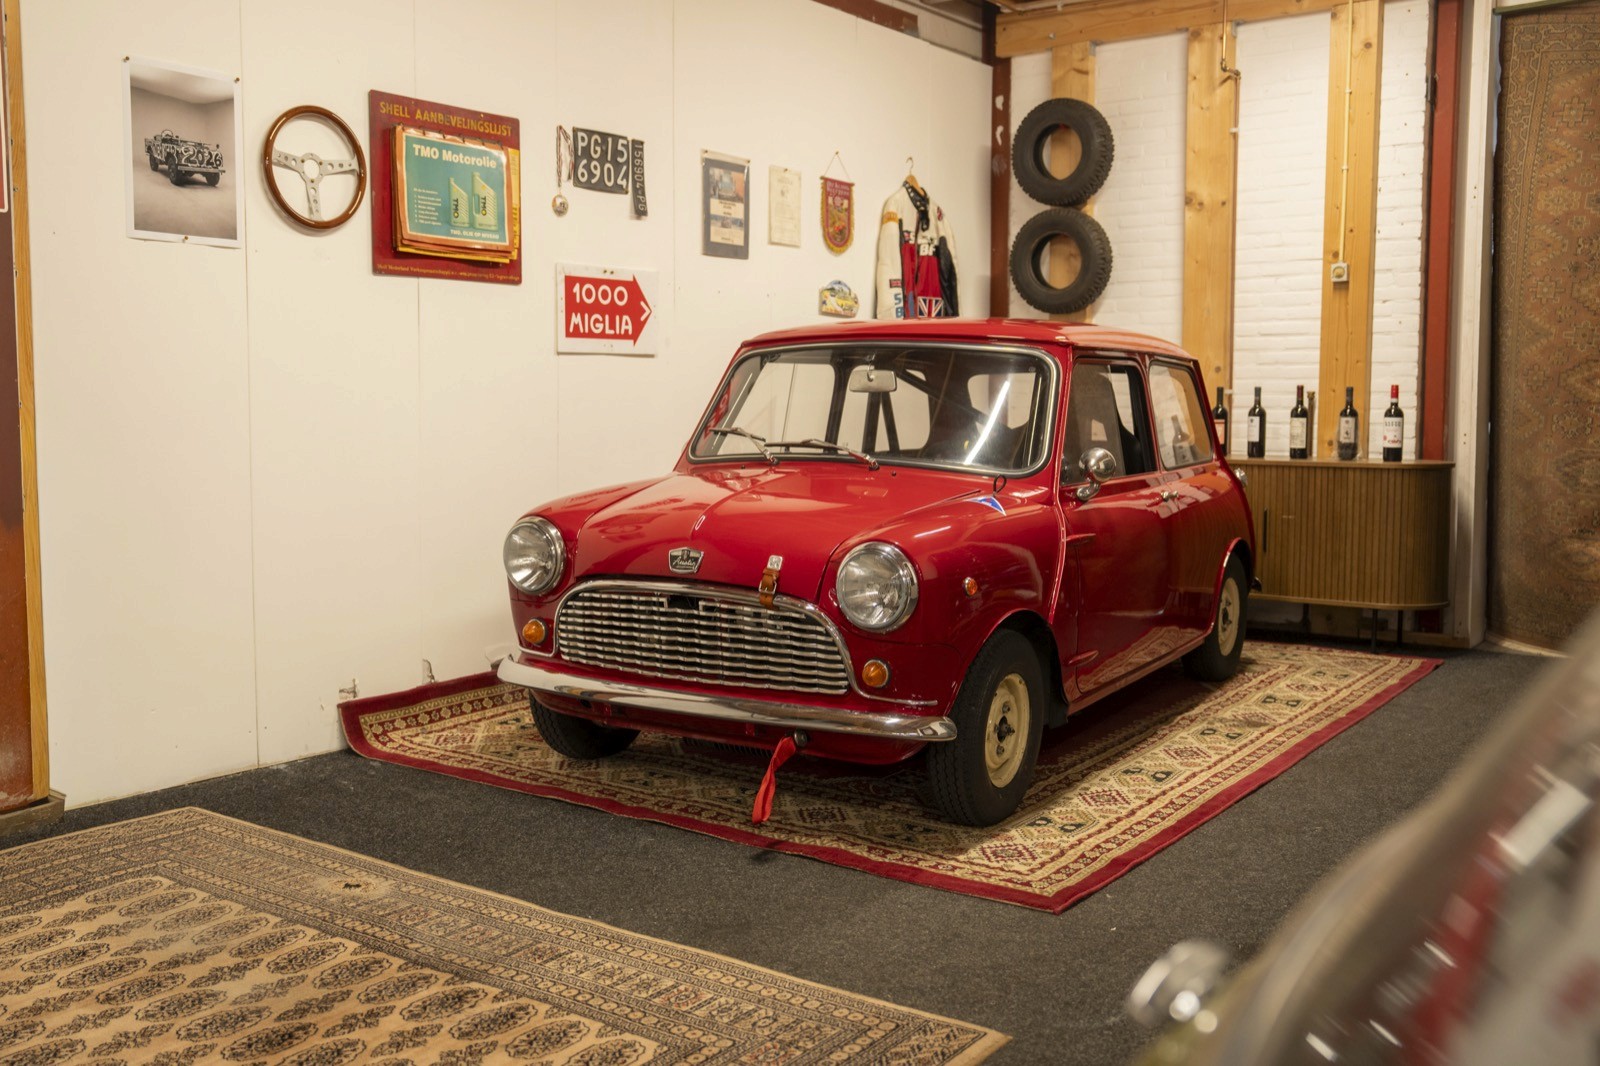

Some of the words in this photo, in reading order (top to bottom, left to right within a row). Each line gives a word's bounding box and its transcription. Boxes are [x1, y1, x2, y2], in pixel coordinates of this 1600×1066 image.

[379, 101, 411, 118] SHELL
[415, 109, 513, 137] AANBEVELINGSLIJST
[181, 145, 223, 167] 2026
[412, 143, 439, 159] TMO
[442, 150, 497, 169] Motorolie
[577, 158, 628, 189] 6904
[572, 282, 629, 306] 1000
[569, 311, 633, 336] MIGLIA
[672, 556, 696, 570] Austin
